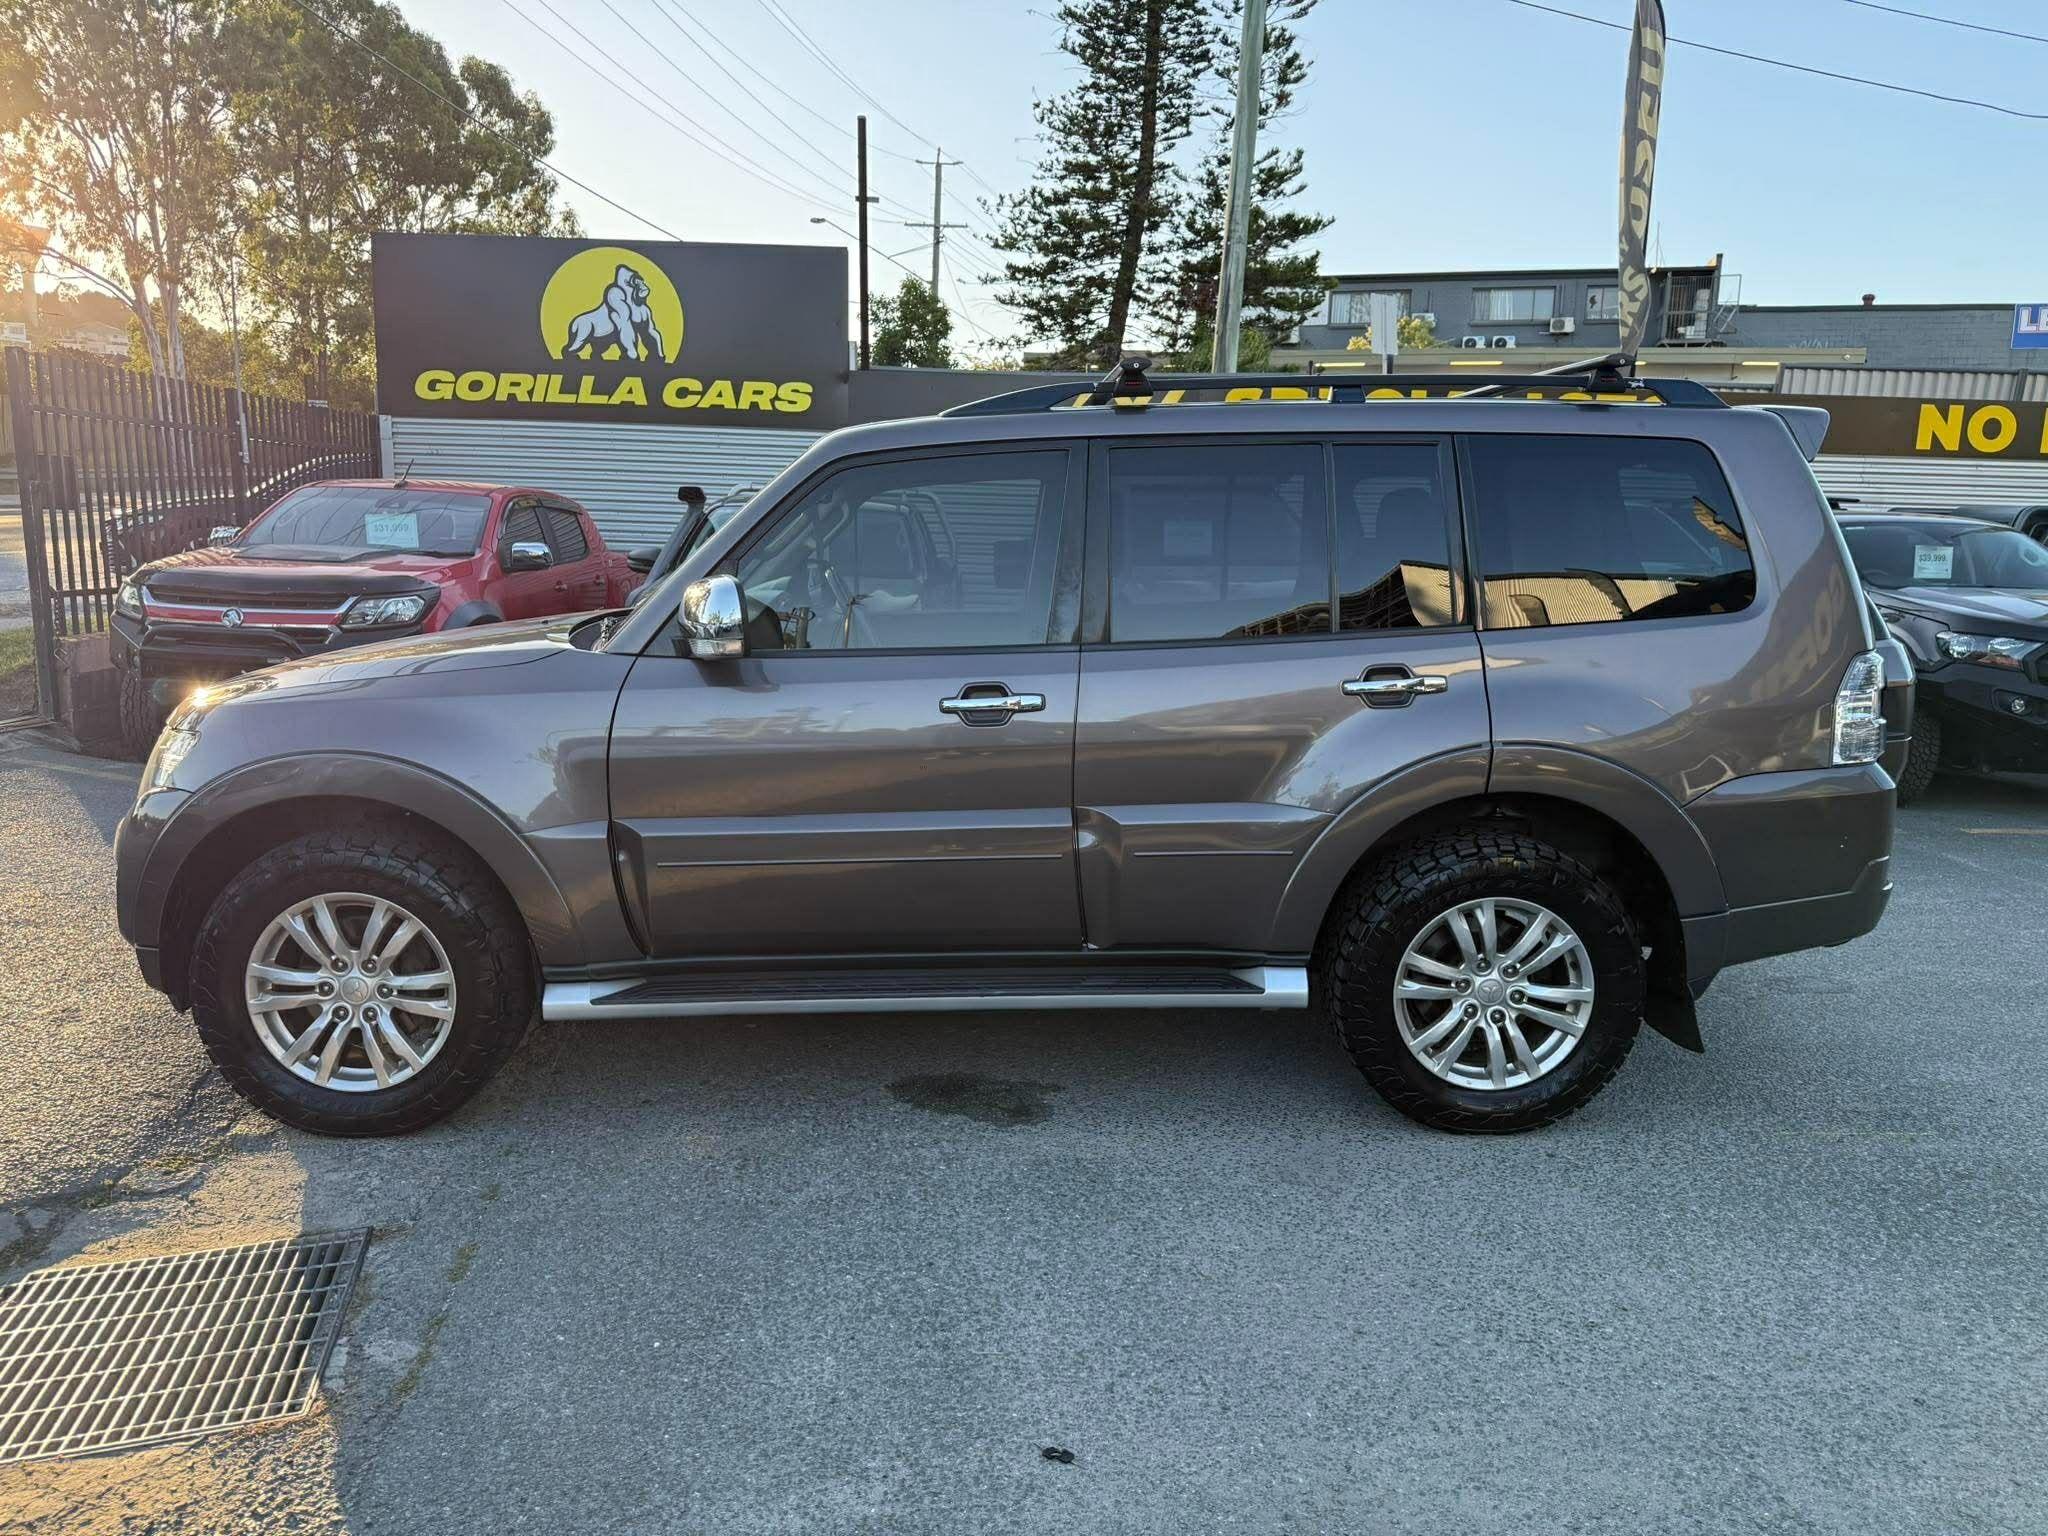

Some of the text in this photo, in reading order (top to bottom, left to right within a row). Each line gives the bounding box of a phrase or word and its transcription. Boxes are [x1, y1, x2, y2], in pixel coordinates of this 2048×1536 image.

[414, 370, 813, 413] GORILLA CARS
[1915, 403, 2018, 454] NO
